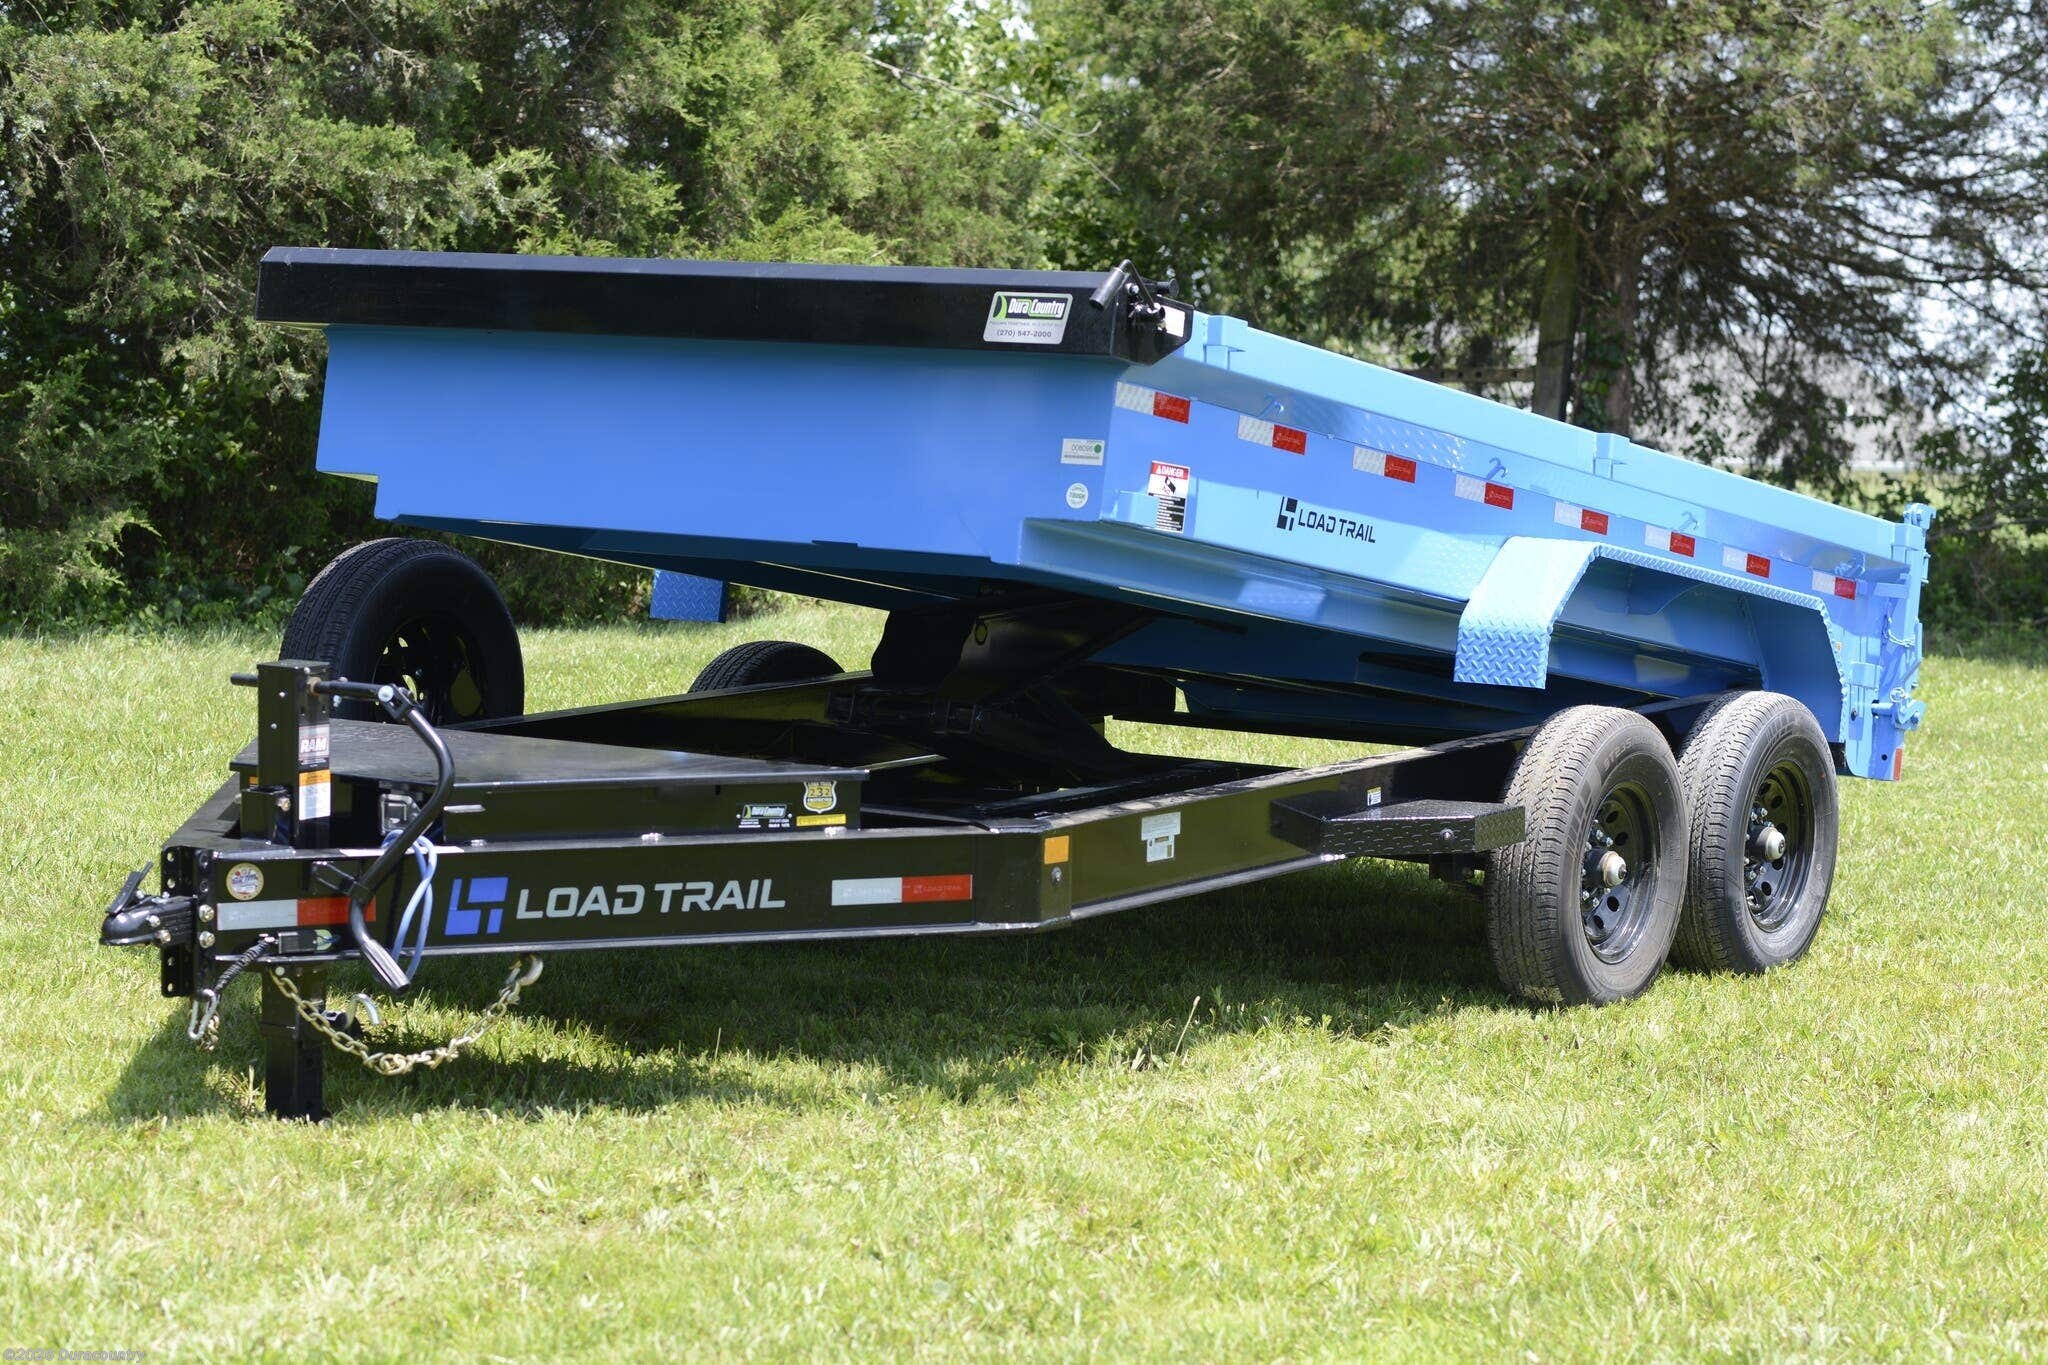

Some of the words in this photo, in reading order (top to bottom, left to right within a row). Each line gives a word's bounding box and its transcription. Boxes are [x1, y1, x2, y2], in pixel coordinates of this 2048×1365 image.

[1008, 298, 1029, 314] Dura
[1031, 299, 1065, 318] Country
[997, 329, 1016, 338] (270)
[1018, 329, 1052, 338] 547-2000
[1161, 465, 1184, 478] DANGER
[1298, 509, 1336, 533] LOAD
[1339, 518, 1376, 543] TRAIL
[301, 738, 327, 753] RAM
[516, 884, 646, 919] LOAD
[654, 879, 786, 913] TRAIL
